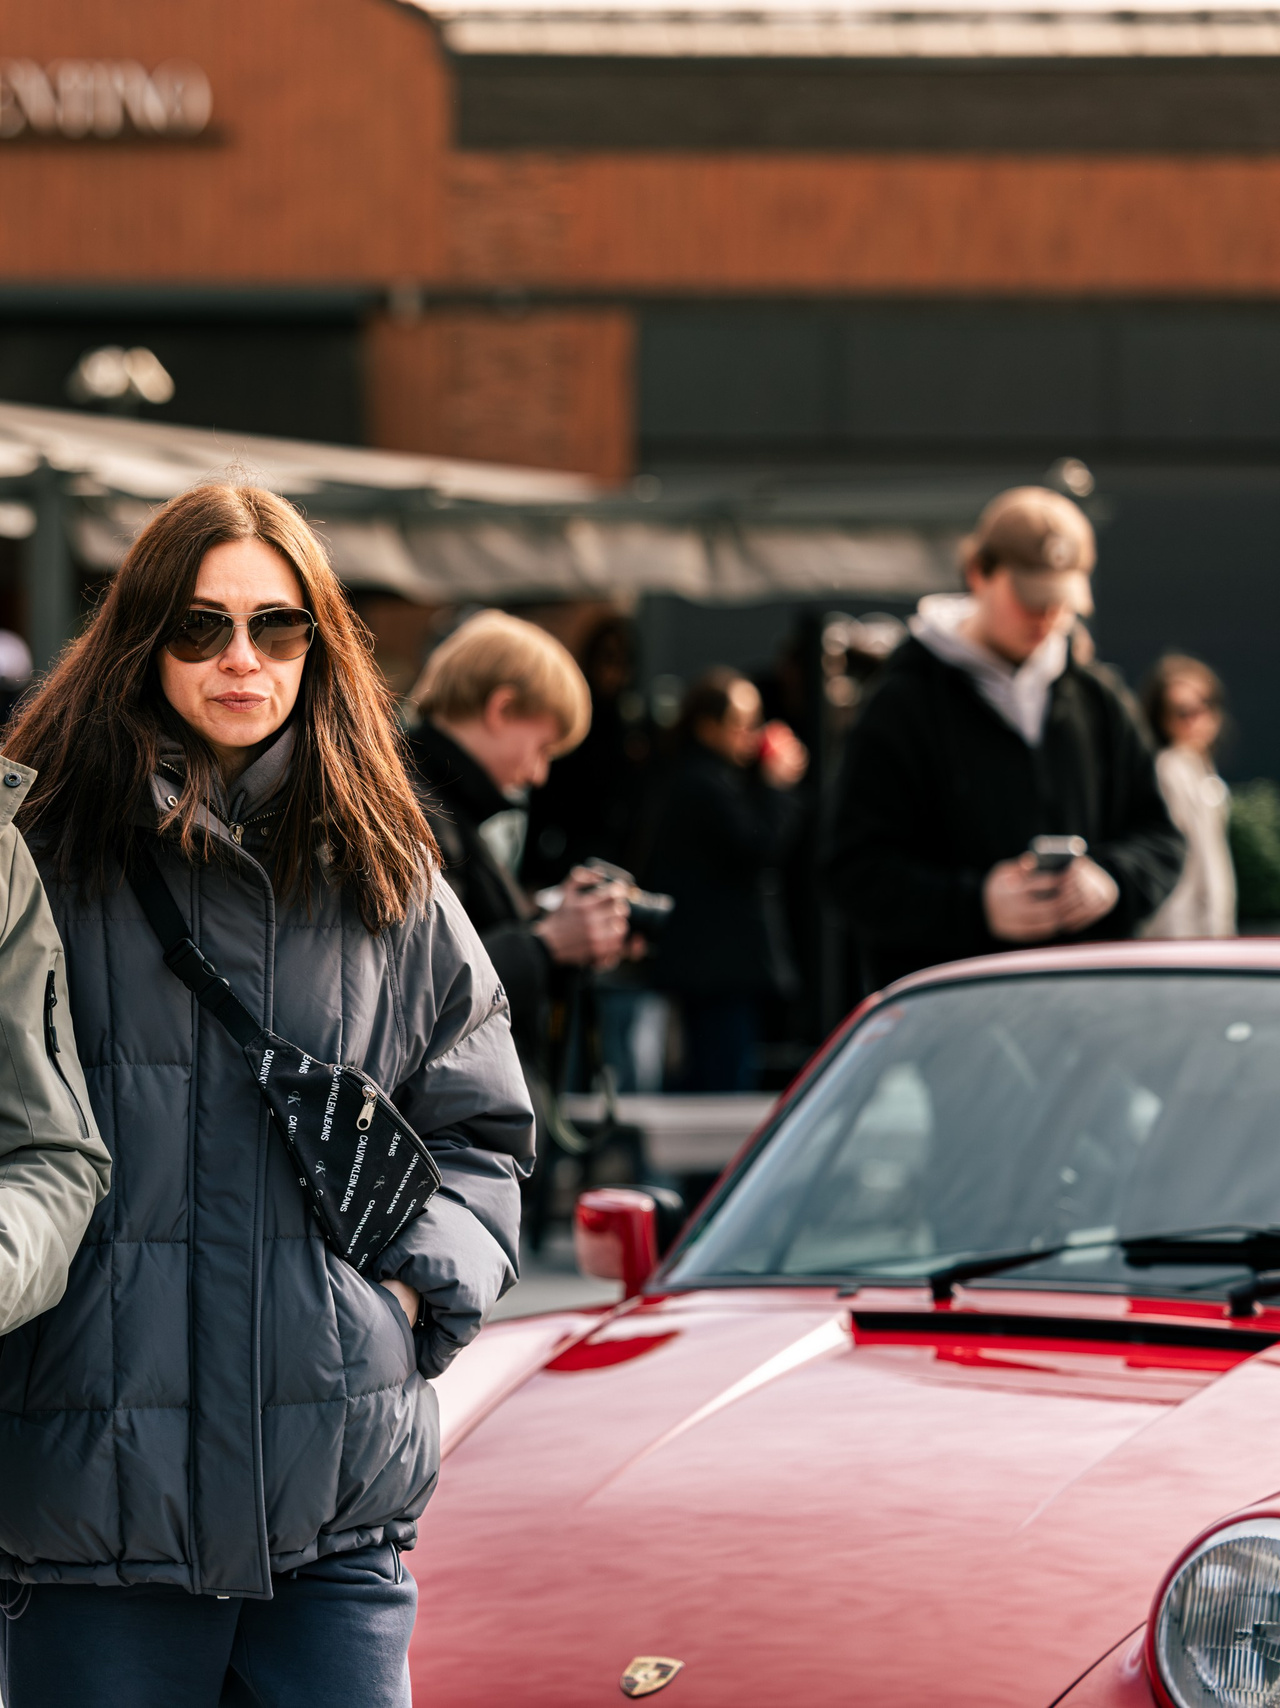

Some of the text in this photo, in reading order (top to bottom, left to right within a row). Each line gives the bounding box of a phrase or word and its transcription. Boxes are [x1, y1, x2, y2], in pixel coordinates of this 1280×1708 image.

[260, 1049, 275, 1076] CALVIN
[298, 1054, 312, 1074] EANS
[325, 1091, 338, 1115] KLEIN
[320, 1114, 333, 1141] JEANS
[388, 1132, 401, 1157] JEANS
[340, 1134, 368, 1212] CALVIN KLEIN JEANS
[398, 1170, 412, 1191] KLEIN
[359, 1199, 376, 1225] CALVIN
[386, 1191, 401, 1214] JEANS
[349, 1225, 363, 1247] KLEIN
